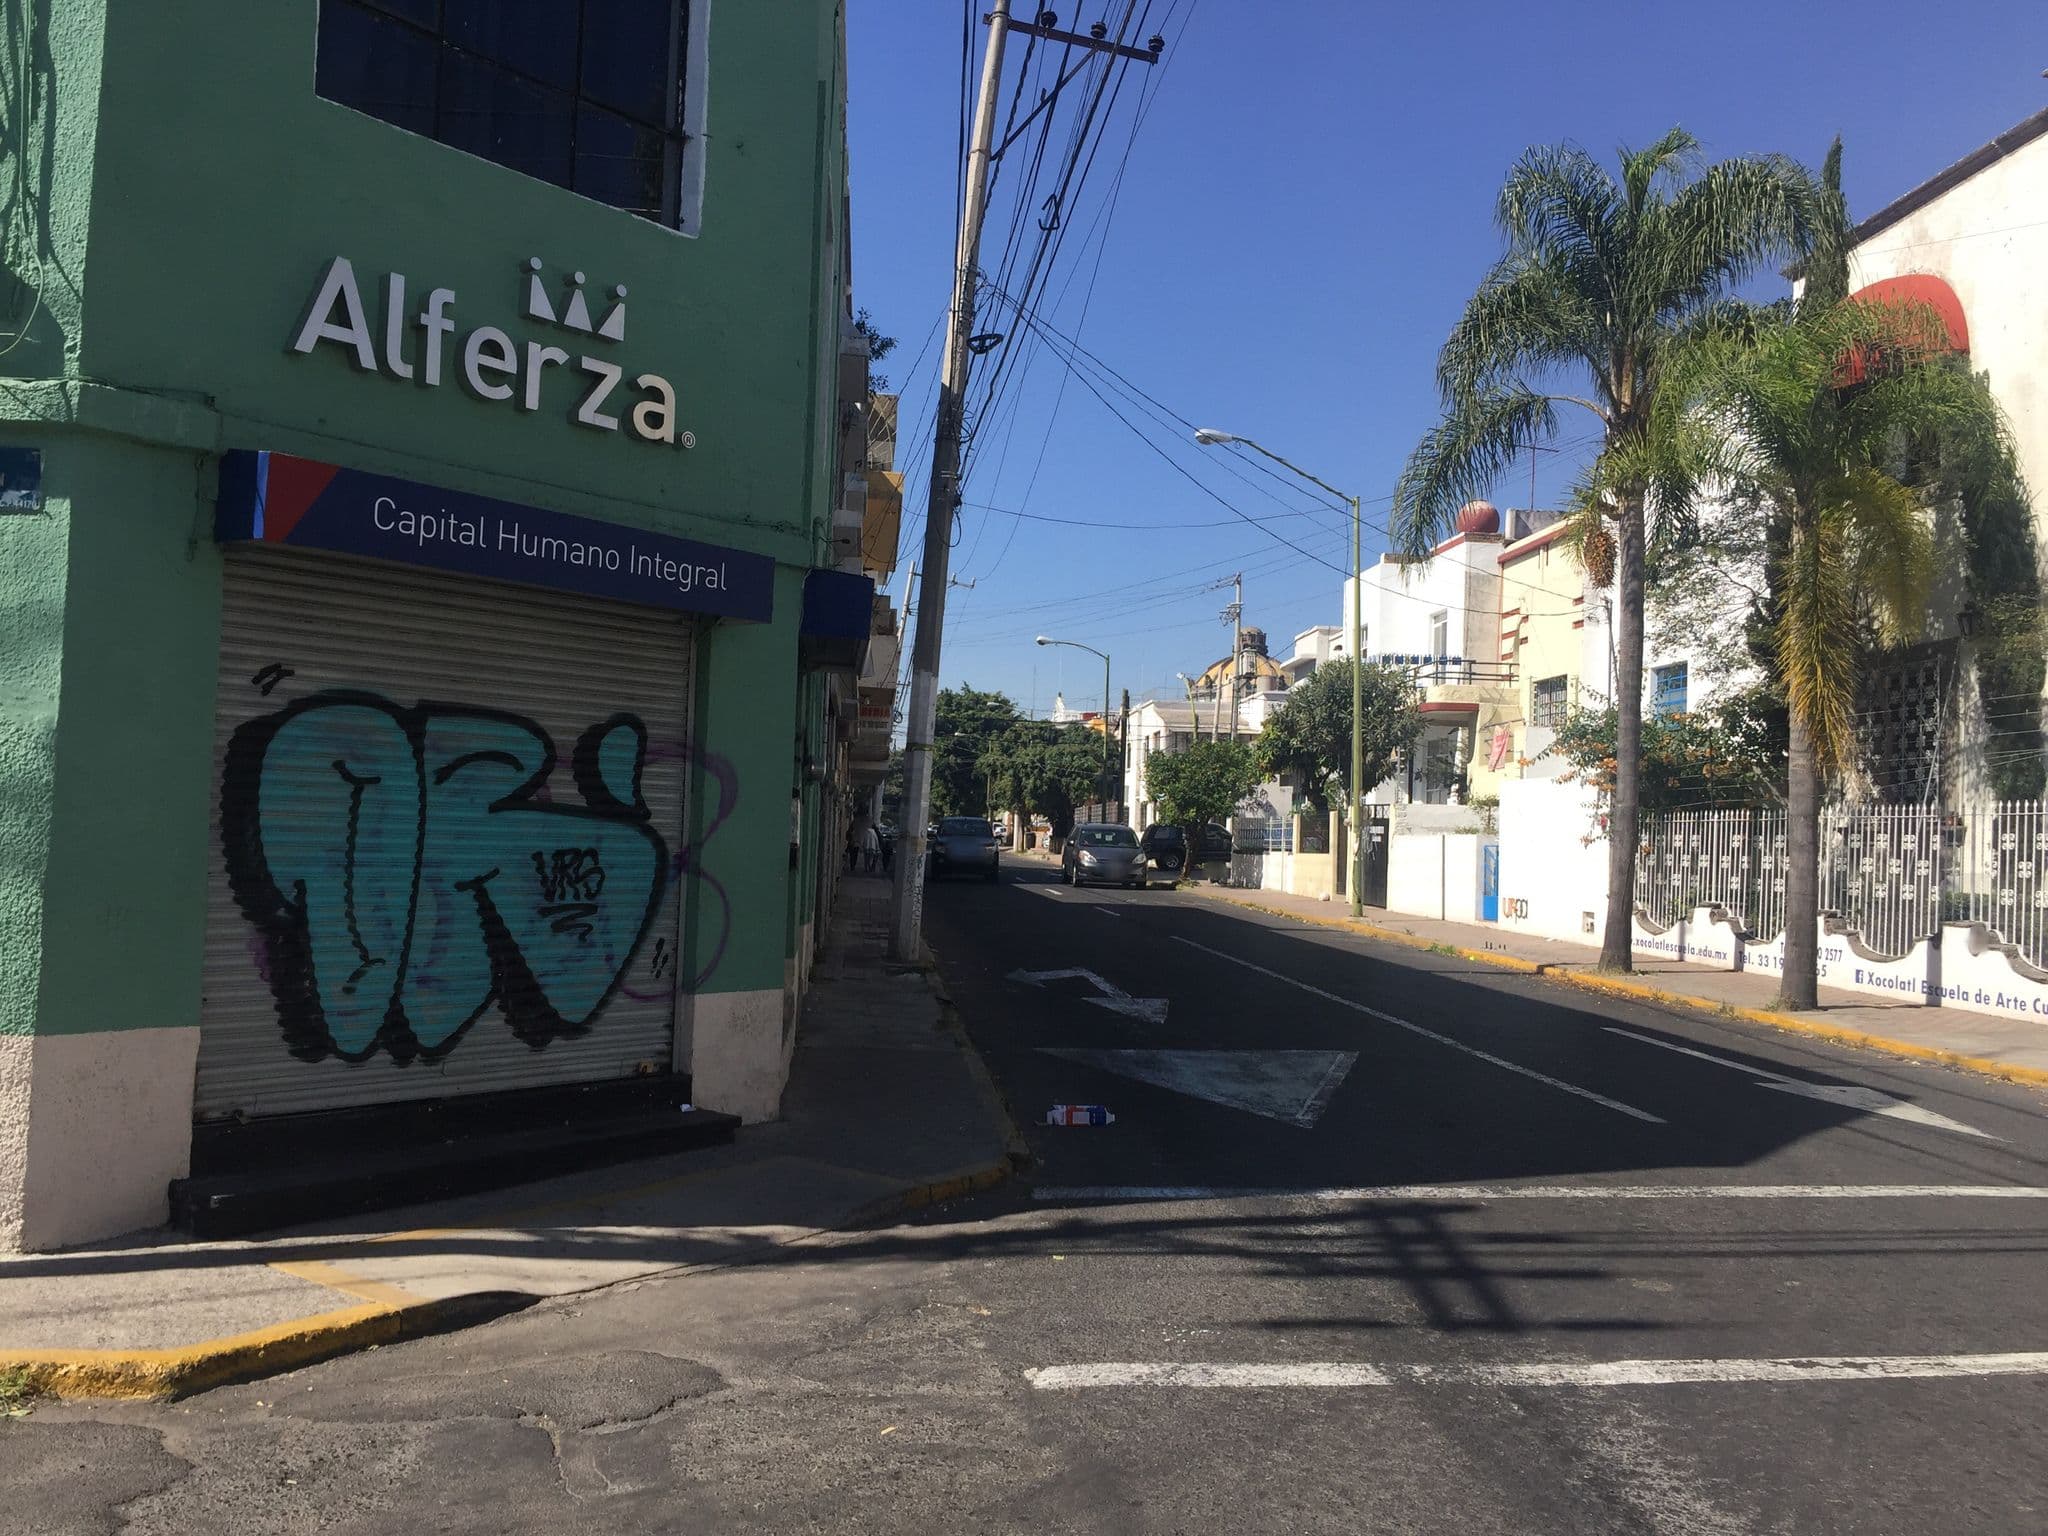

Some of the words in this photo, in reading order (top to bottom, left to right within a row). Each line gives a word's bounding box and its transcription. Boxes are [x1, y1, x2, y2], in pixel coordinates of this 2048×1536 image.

[294, 255, 676, 445] Alferza
[373, 497, 487, 546] Capital
[498, 519, 620, 570] Humano
[629, 544, 727, 592] Integral
[1738, 951, 1754, 965] Tel.
[1758, 954, 1769, 968] 33
[1824, 948, 1843, 962] 2577
[1868, 971, 1916, 993] Xocolatl
[1921, 980, 1969, 1001] Escuela
[1975, 988, 1990, 1005] de
[1996, 992, 2027, 1011] Arte
